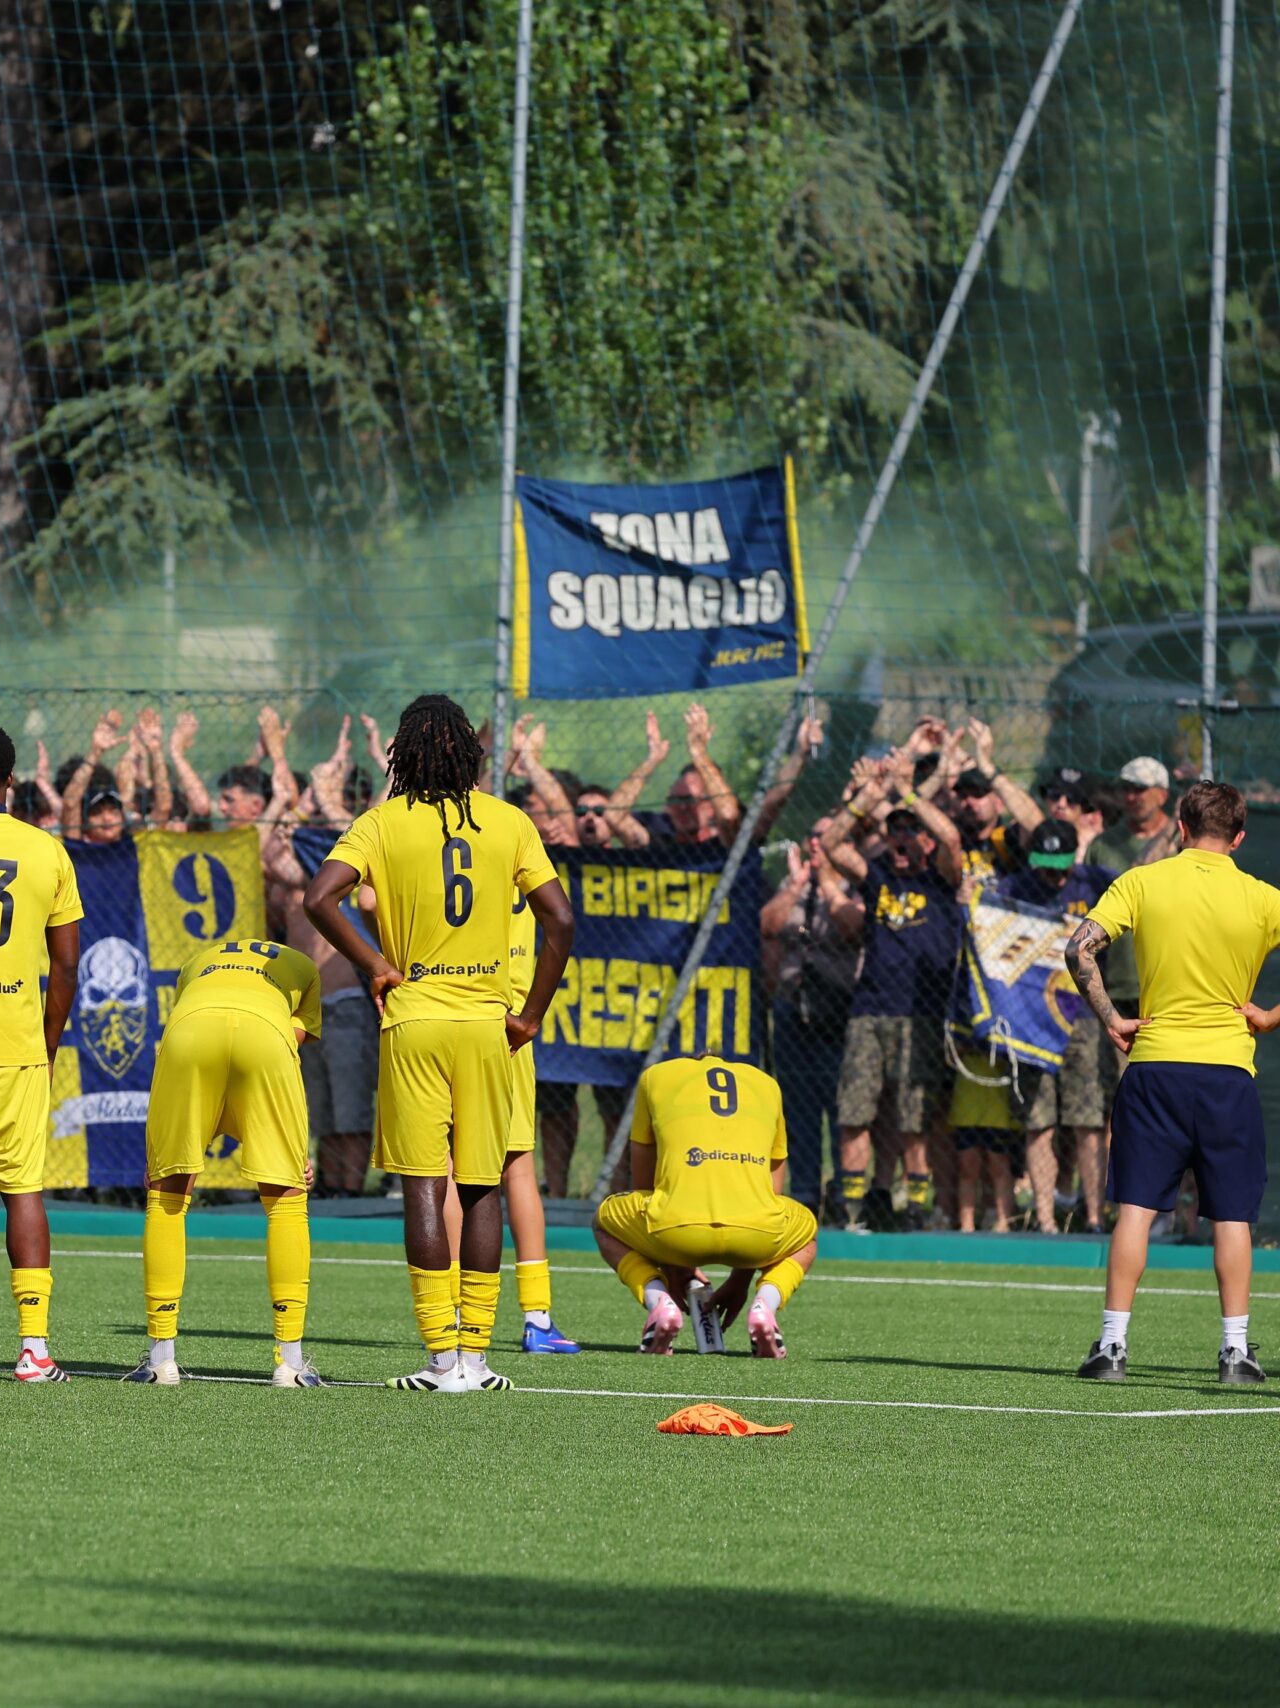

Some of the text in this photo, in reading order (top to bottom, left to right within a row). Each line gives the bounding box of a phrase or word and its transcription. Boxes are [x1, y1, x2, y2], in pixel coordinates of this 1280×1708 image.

[591, 508, 731, 566] ZONA
[547, 569, 787, 637] SQUAGLIO
[173, 853, 236, 939] 9
[442, 836, 474, 928] 6
[540, 956, 751, 1055] RESENTI
[706, 1066, 738, 1117] 9
